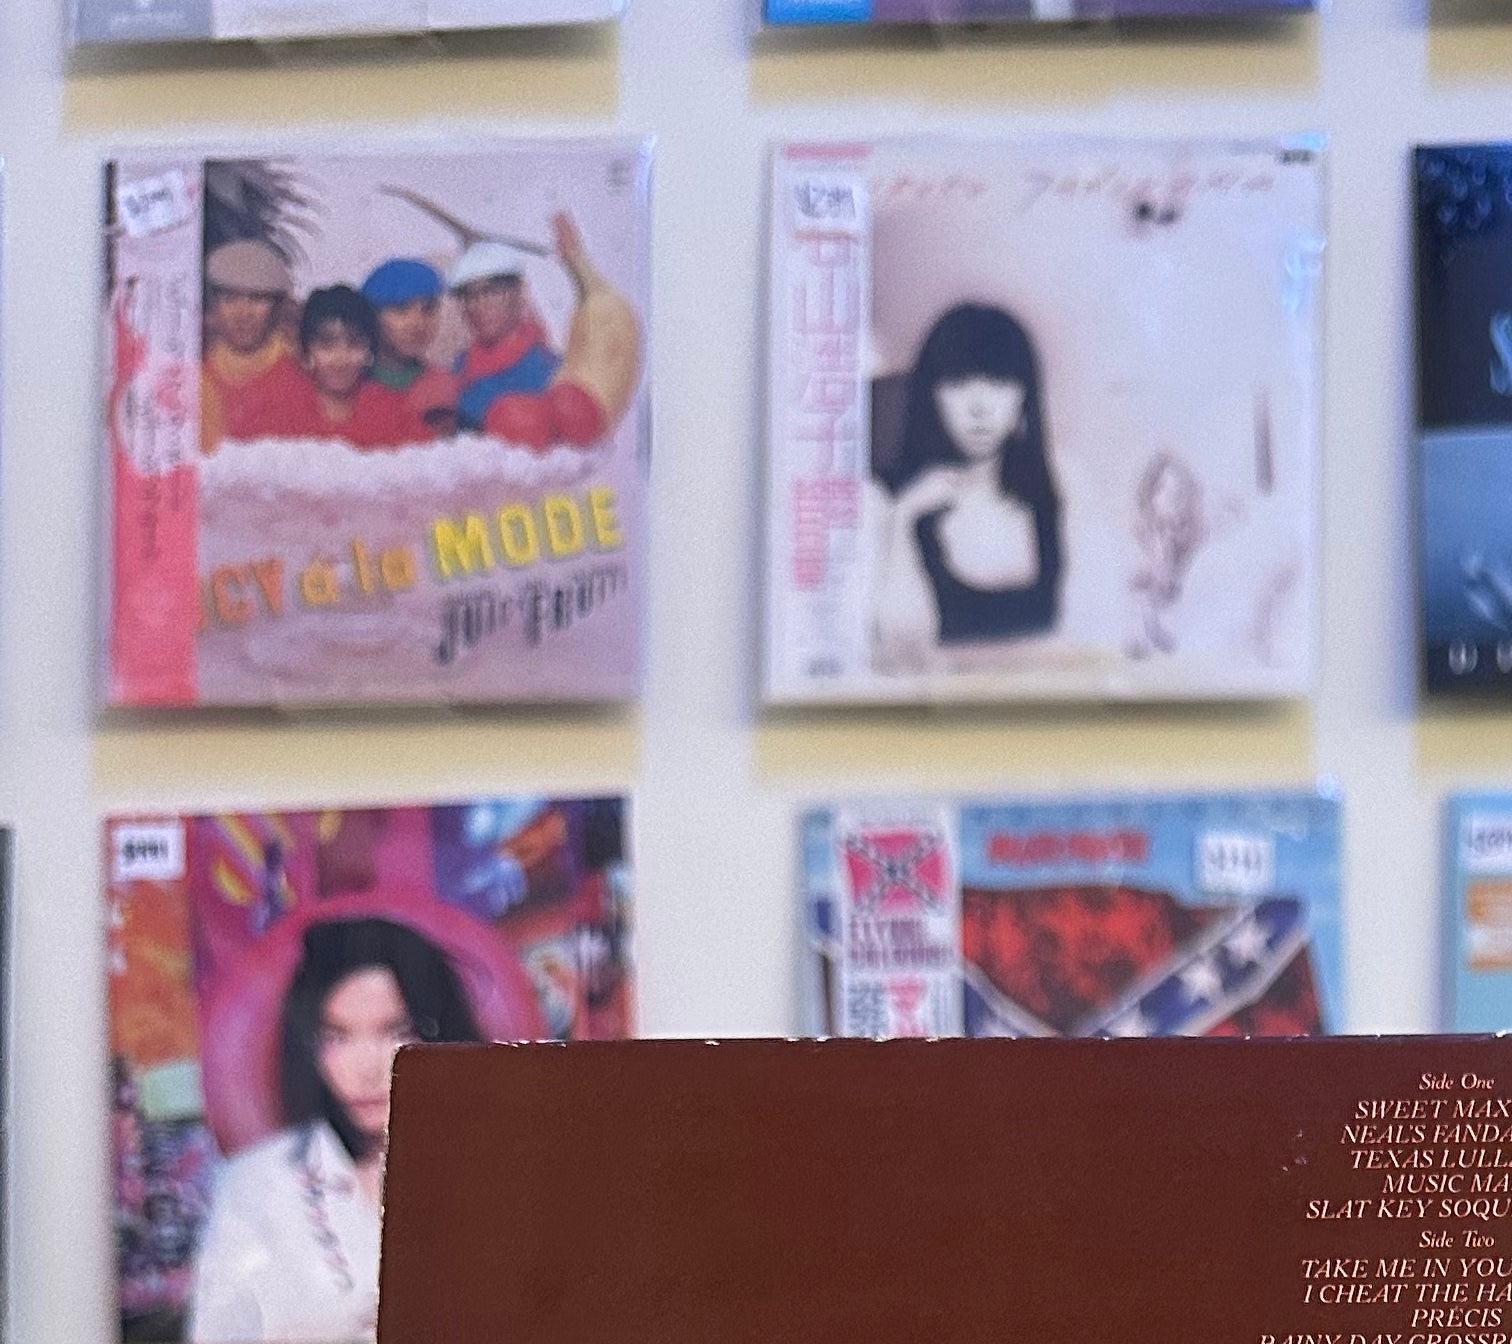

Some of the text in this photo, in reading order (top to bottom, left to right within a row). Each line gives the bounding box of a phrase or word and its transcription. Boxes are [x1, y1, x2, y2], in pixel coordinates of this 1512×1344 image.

[430, 486, 625, 581] MODE
[1419, 1073, 1494, 1089] Side One
[1355, 1100, 1447, 1119] SWEET
[1352, 1150, 1433, 1168] TEXAS
[1383, 1174, 1464, 1193] MUSIC
[1307, 1200, 1371, 1218] SLAT
[1378, 1200, 1433, 1217] KEY
[1419, 1231, 1494, 1247] Side Two
[1302, 1259, 1368, 1278] TAKE
[1376, 1259, 1415, 1277] ME
[1423, 1259, 1450, 1277] IN
[1304, 1285, 1312, 1303] I
[1319, 1284, 1406, 1304] CHEAT
[1416, 1283, 1468, 1302] THE
